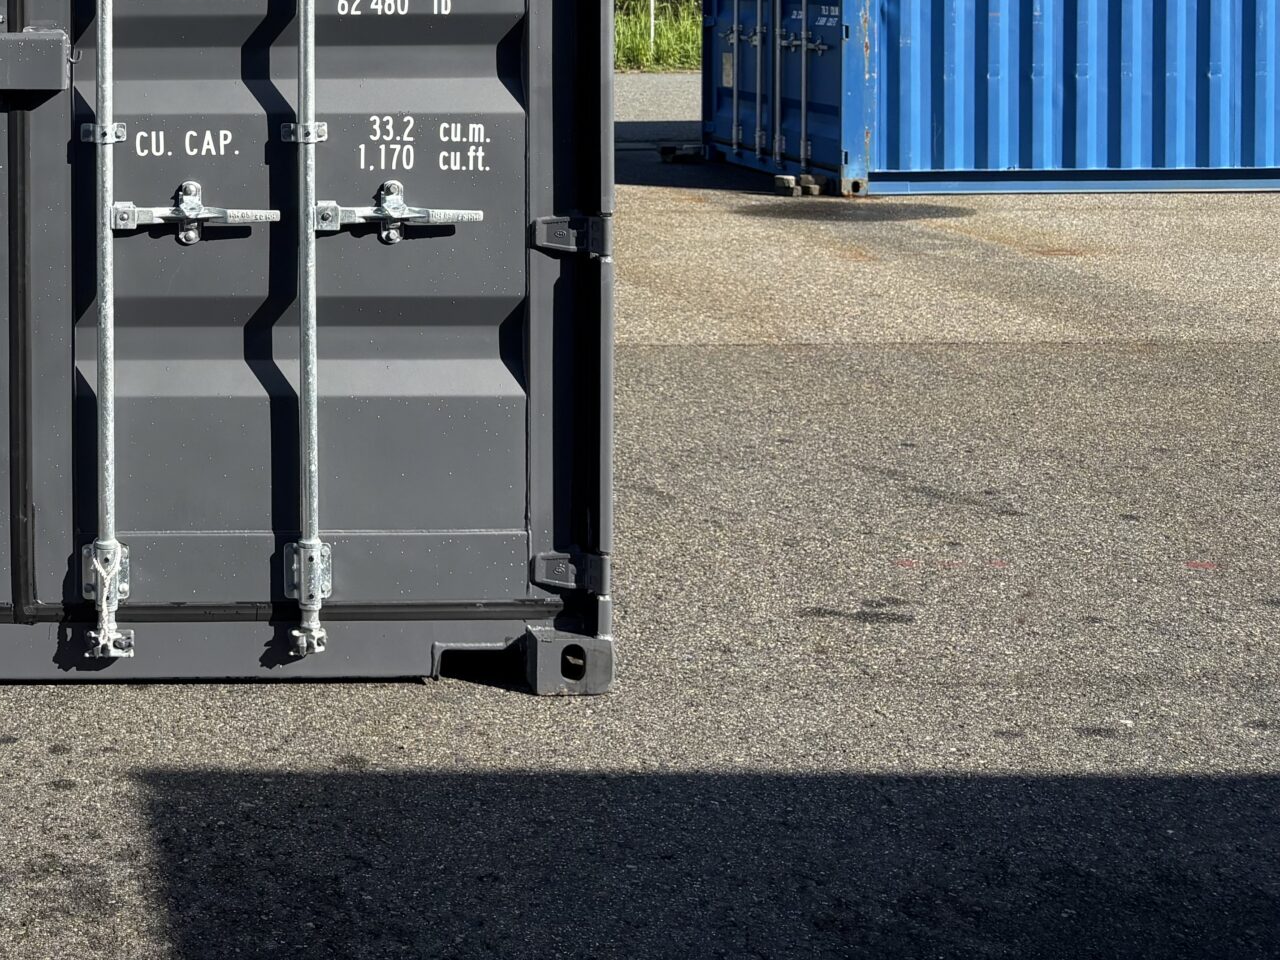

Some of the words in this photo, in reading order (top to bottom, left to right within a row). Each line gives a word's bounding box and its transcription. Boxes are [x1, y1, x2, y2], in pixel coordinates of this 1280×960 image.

[369, 115, 414, 142] 33.2
[439, 122, 491, 143] cu.m.
[135, 131, 172, 157] CU.
[184, 130, 240, 156] CAP.
[358, 144, 414, 171] 1,170
[439, 145, 490, 171] cu.ft.
